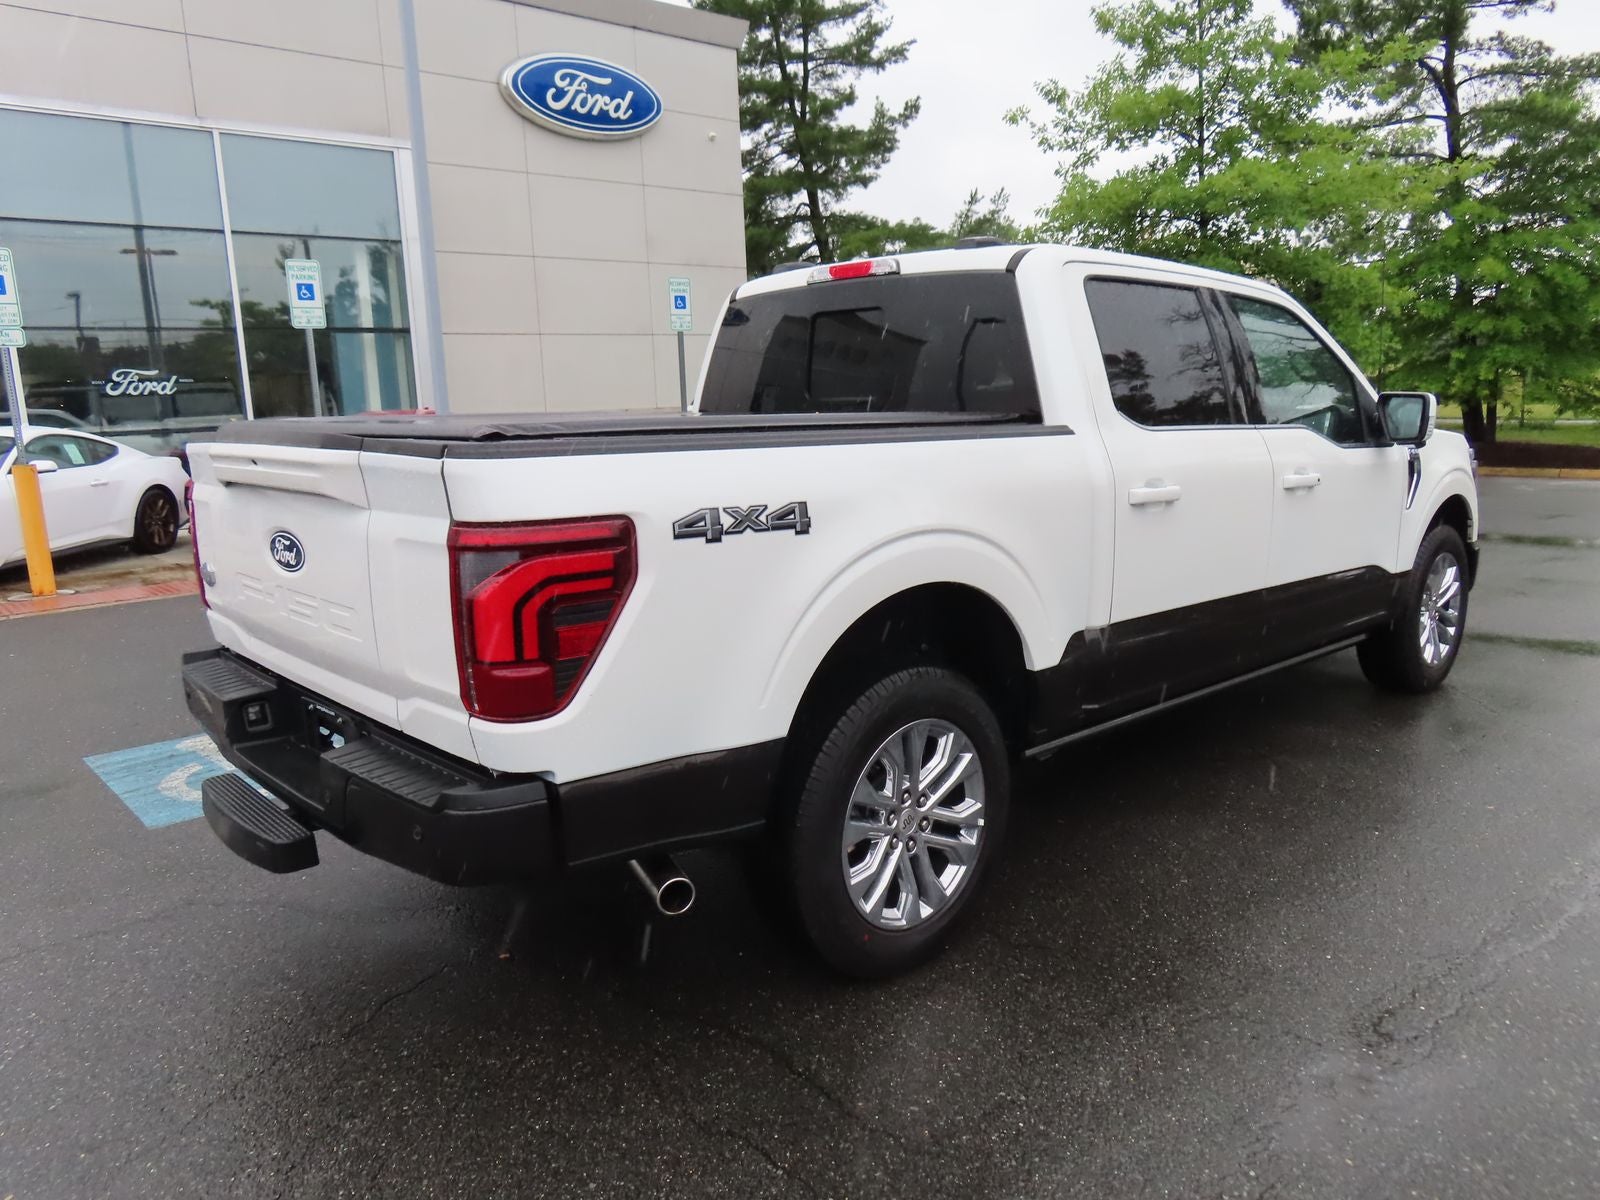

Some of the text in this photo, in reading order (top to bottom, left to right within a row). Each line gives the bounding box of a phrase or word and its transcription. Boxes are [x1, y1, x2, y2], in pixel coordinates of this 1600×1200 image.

[546, 68, 635, 121] Ford
[288, 265, 319, 273] RESERVED
[291, 273, 317, 281] PARKING
[105, 368, 178, 397] Ford
[274, 536, 297, 566] Ford
